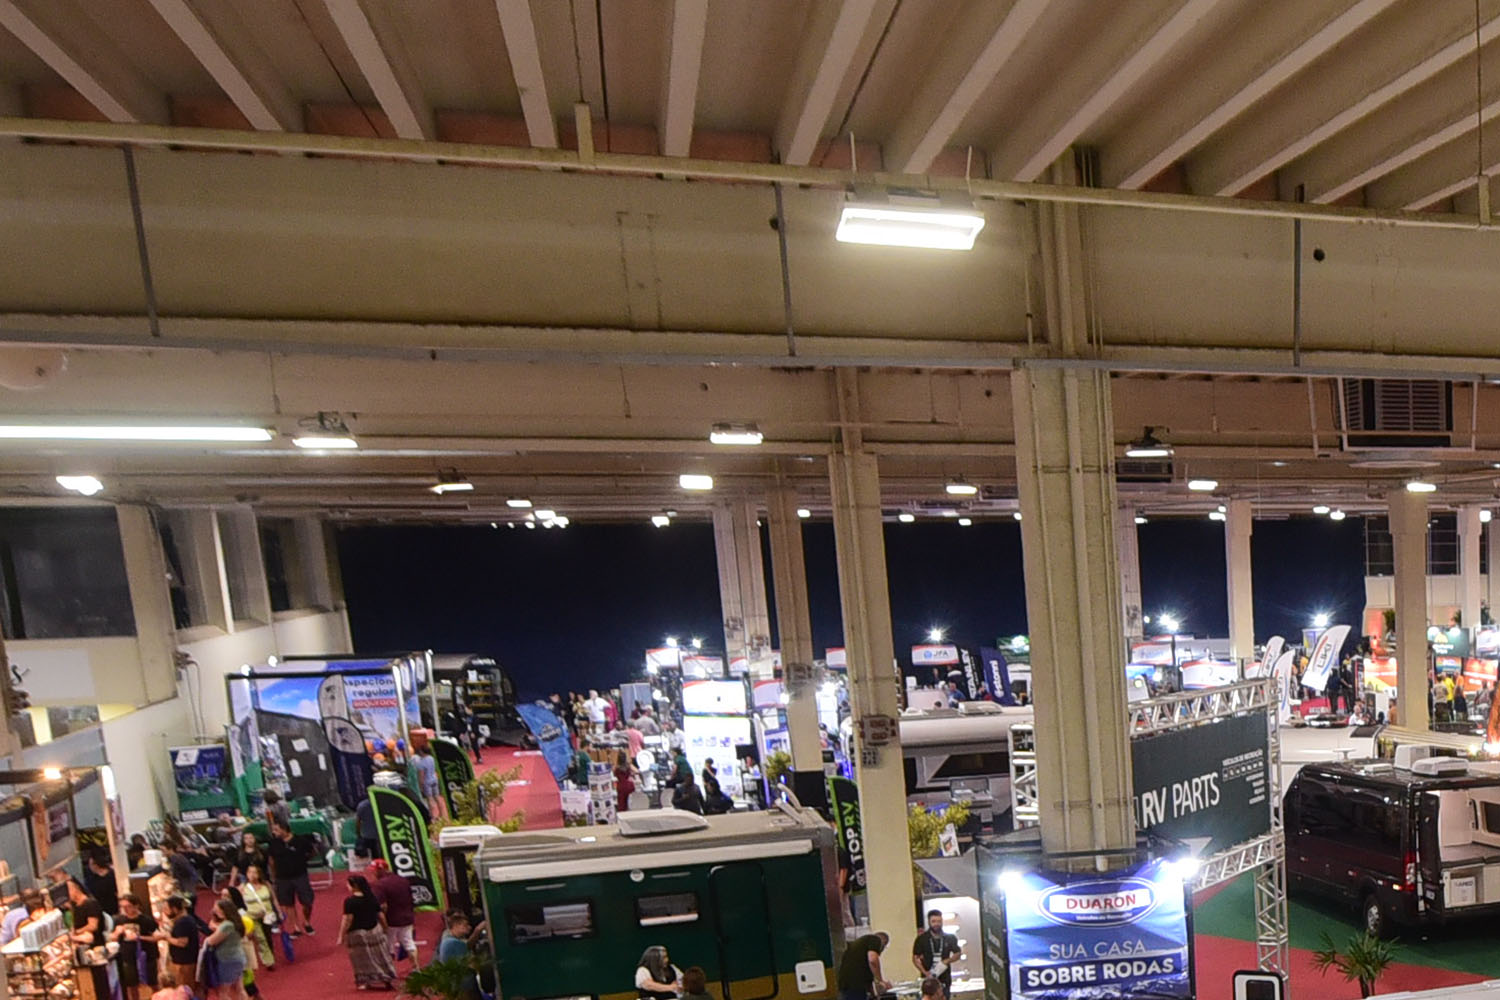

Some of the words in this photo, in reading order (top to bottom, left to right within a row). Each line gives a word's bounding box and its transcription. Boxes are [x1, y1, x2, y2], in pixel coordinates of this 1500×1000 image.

[961, 648, 977, 700] STANLEY
[1142, 786, 1167, 829] RV
[1172, 772, 1220, 818] PARTS
[1066, 894, 1136, 910] DUARON
[1049, 943, 1088, 960] SUA
[1094, 939, 1147, 957] CASA
[1027, 964, 1097, 987] SOBRE
[1103, 957, 1175, 980] RODAS
